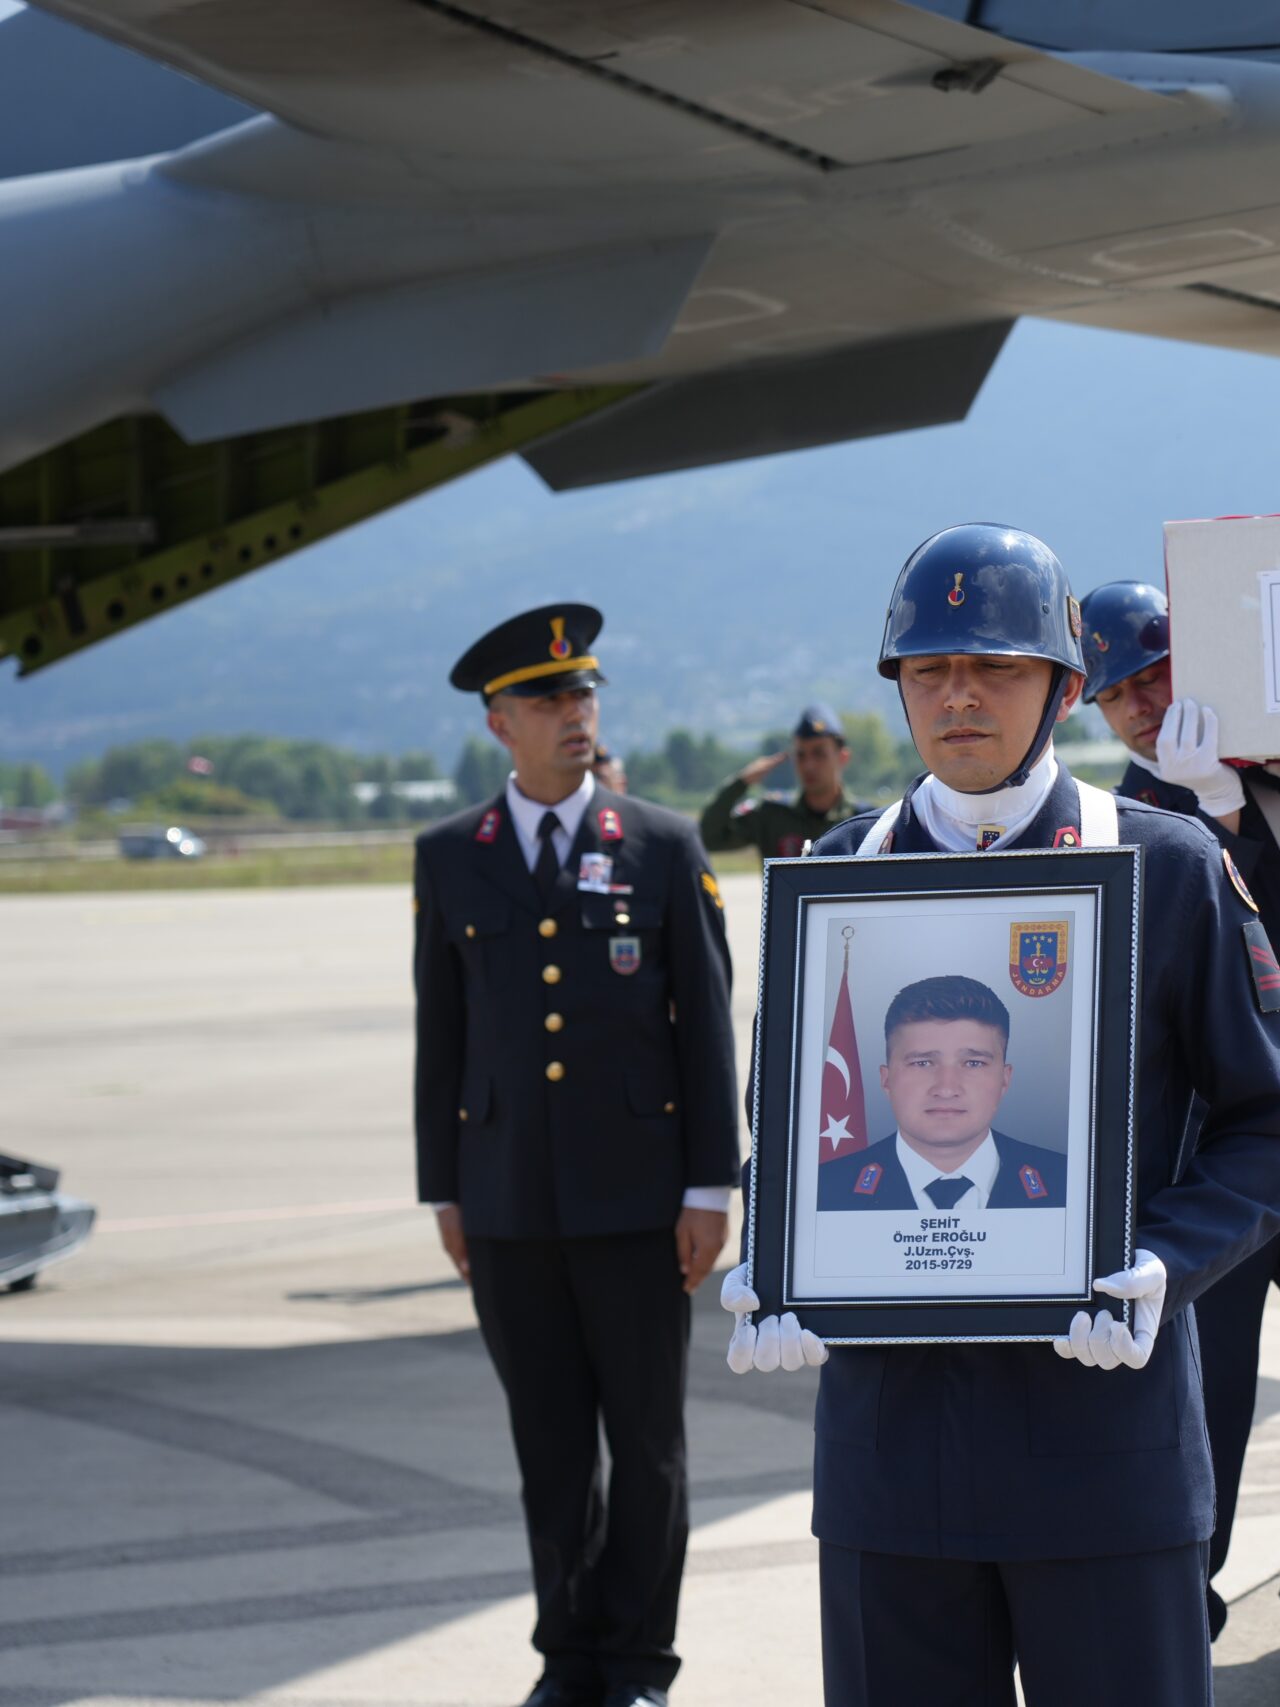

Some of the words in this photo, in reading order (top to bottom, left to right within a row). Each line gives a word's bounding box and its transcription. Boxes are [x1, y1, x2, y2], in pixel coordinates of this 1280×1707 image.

[1012, 971, 1064, 996] JANDARMA
[920, 1216, 960, 1231] ŞEHİT
[893, 1231, 928, 1243] Ömer
[932, 1230, 986, 1242] EROĞLU
[904, 1246, 974, 1258] J.Uzm.Çvş.
[905, 1259, 972, 1270] 2015-9729
